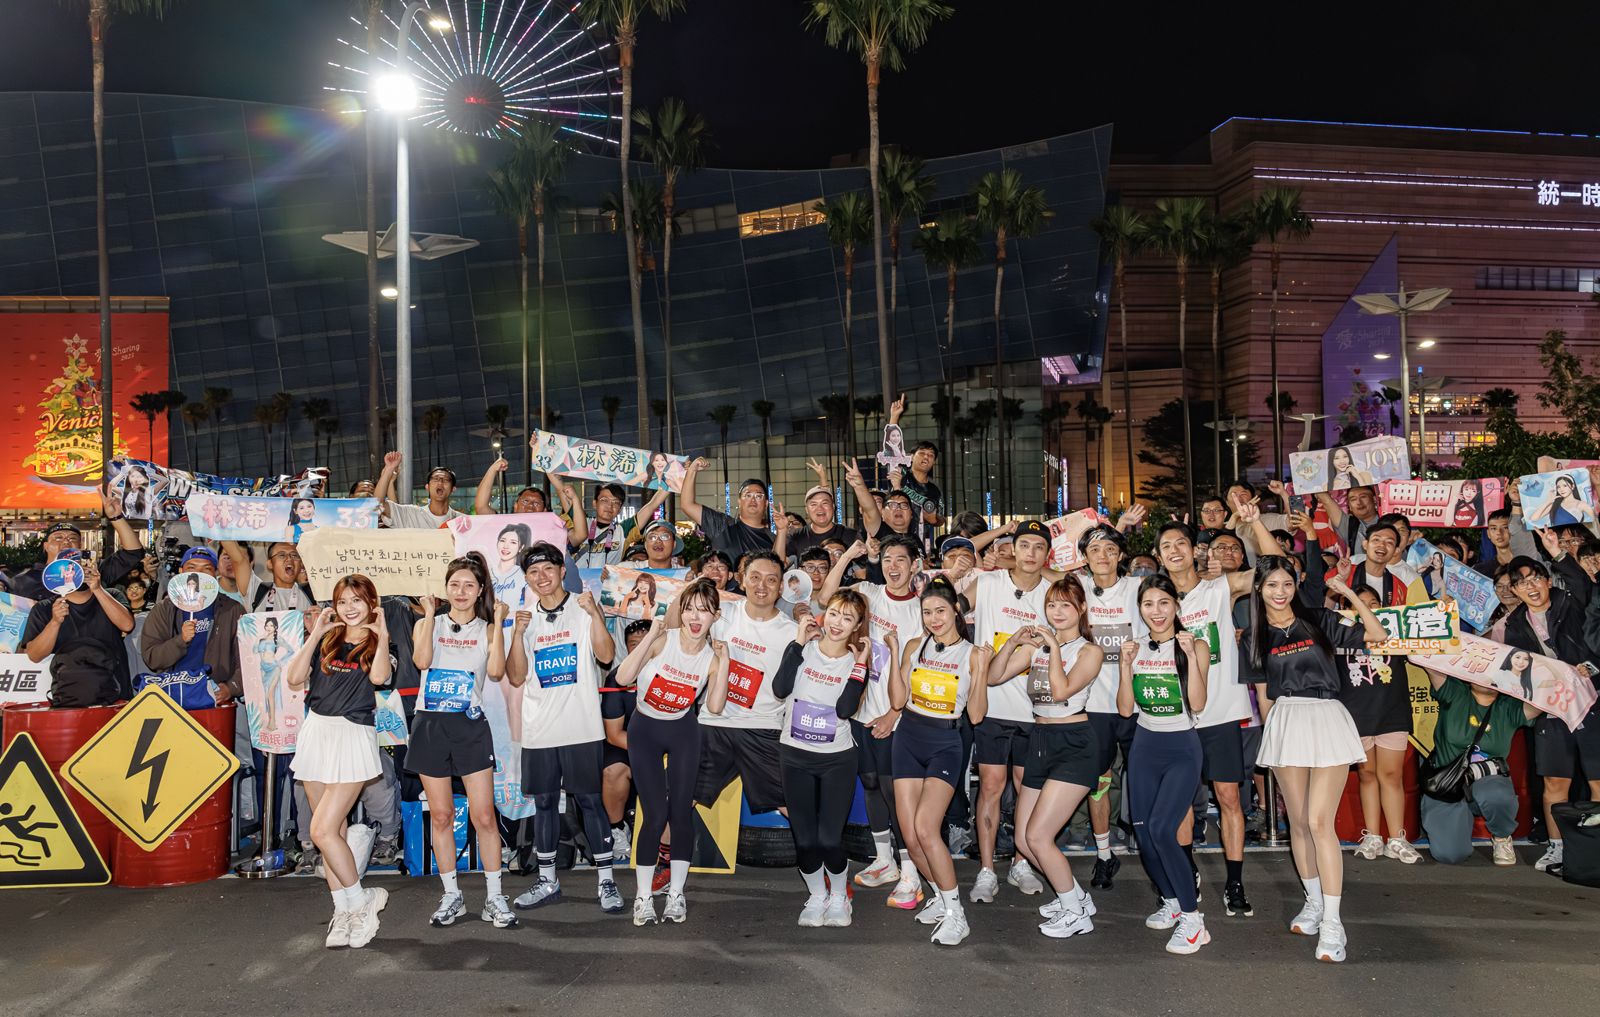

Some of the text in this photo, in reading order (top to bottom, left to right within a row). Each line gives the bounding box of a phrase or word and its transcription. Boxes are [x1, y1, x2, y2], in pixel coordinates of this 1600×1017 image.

[1538, 180, 1600, 207] 統一時
[112, 344, 140, 356] Sharing
[39, 411, 104, 433] Venic
[536, 454, 552, 470] 33
[577, 444, 637, 475] 林浠
[1365, 446, 1402, 470] JOY
[203, 498, 269, 530] 林浠
[336, 507, 372, 529] 33
[1419, 508, 1443, 517] CHU
[336, 549, 375, 562] 남민정
[379, 549, 408, 562] 최고!
[411, 549, 424, 561] 내
[335, 567, 361, 575] 네가
[365, 566, 403, 579] 언제나
[1468, 606, 1484, 624] 98
[1094, 634, 1129, 648] YORK
[536, 655, 577, 671] TRAVIS
[552, 674, 573, 683] 0012
[428, 681, 469, 700] 南珉貞
[728, 691, 748, 703] 0012
[1142, 686, 1170, 699] 林浠
[1547, 679, 1576, 712] 33
[440, 701, 463, 709] 0012
[925, 701, 947, 710] 0012
[1152, 705, 1175, 713] 0012
[800, 713, 827, 729] 曲曲
[804, 733, 828, 741] 0012
